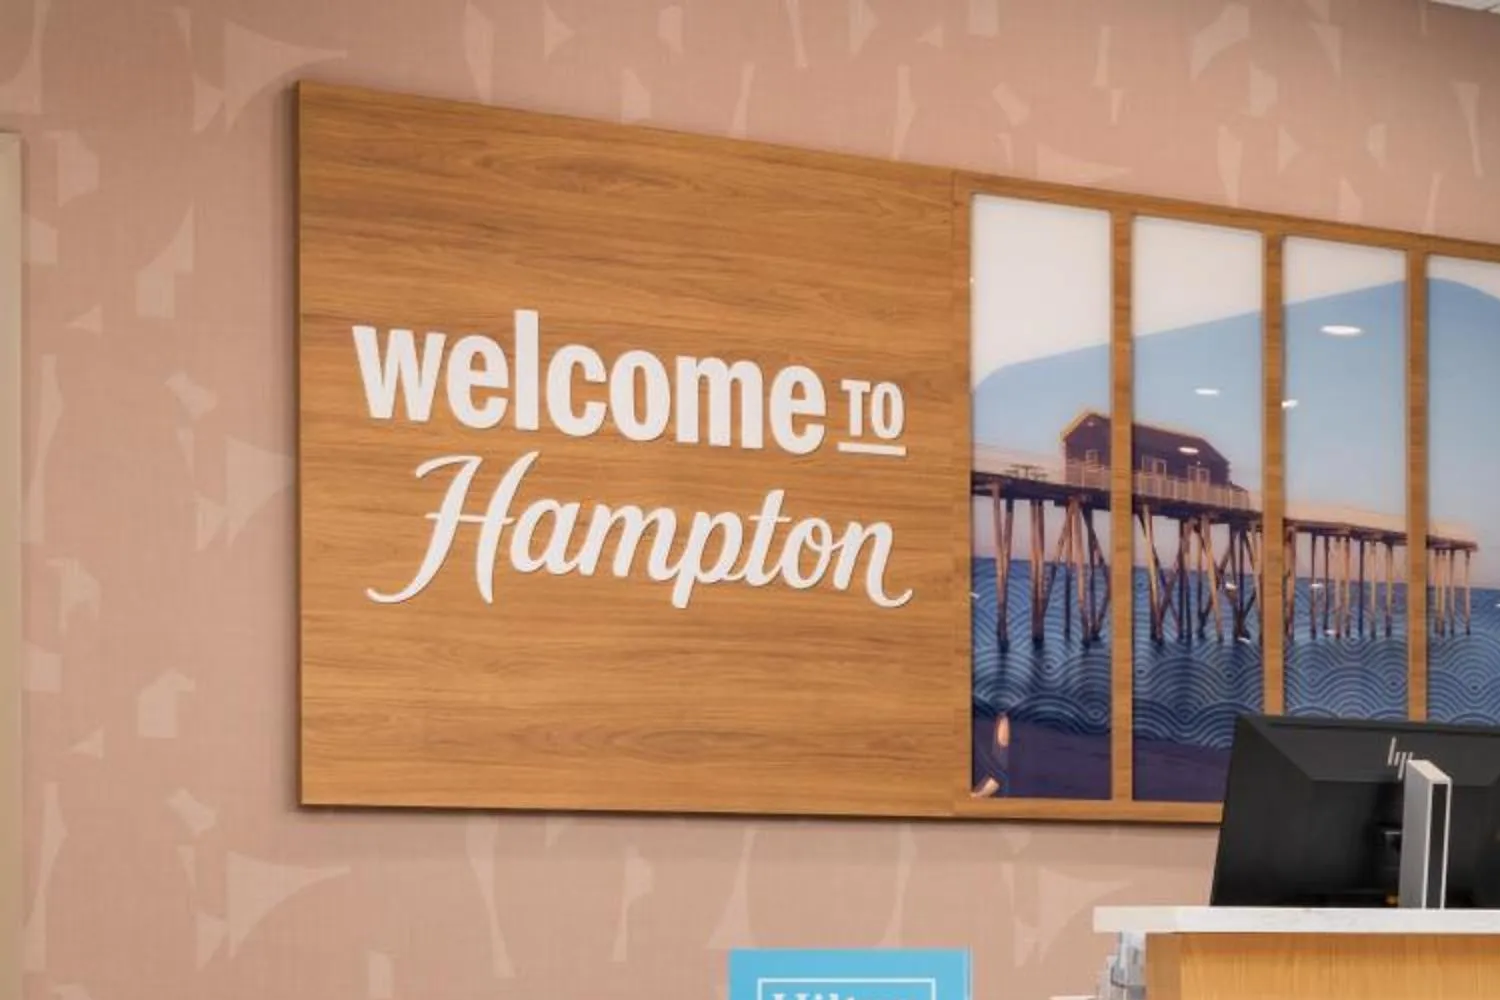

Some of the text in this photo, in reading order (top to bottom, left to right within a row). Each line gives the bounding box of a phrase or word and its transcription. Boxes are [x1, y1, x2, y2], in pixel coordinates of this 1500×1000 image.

[352, 310, 904, 454] welcome TO
[367, 451, 913, 609] Hampton
